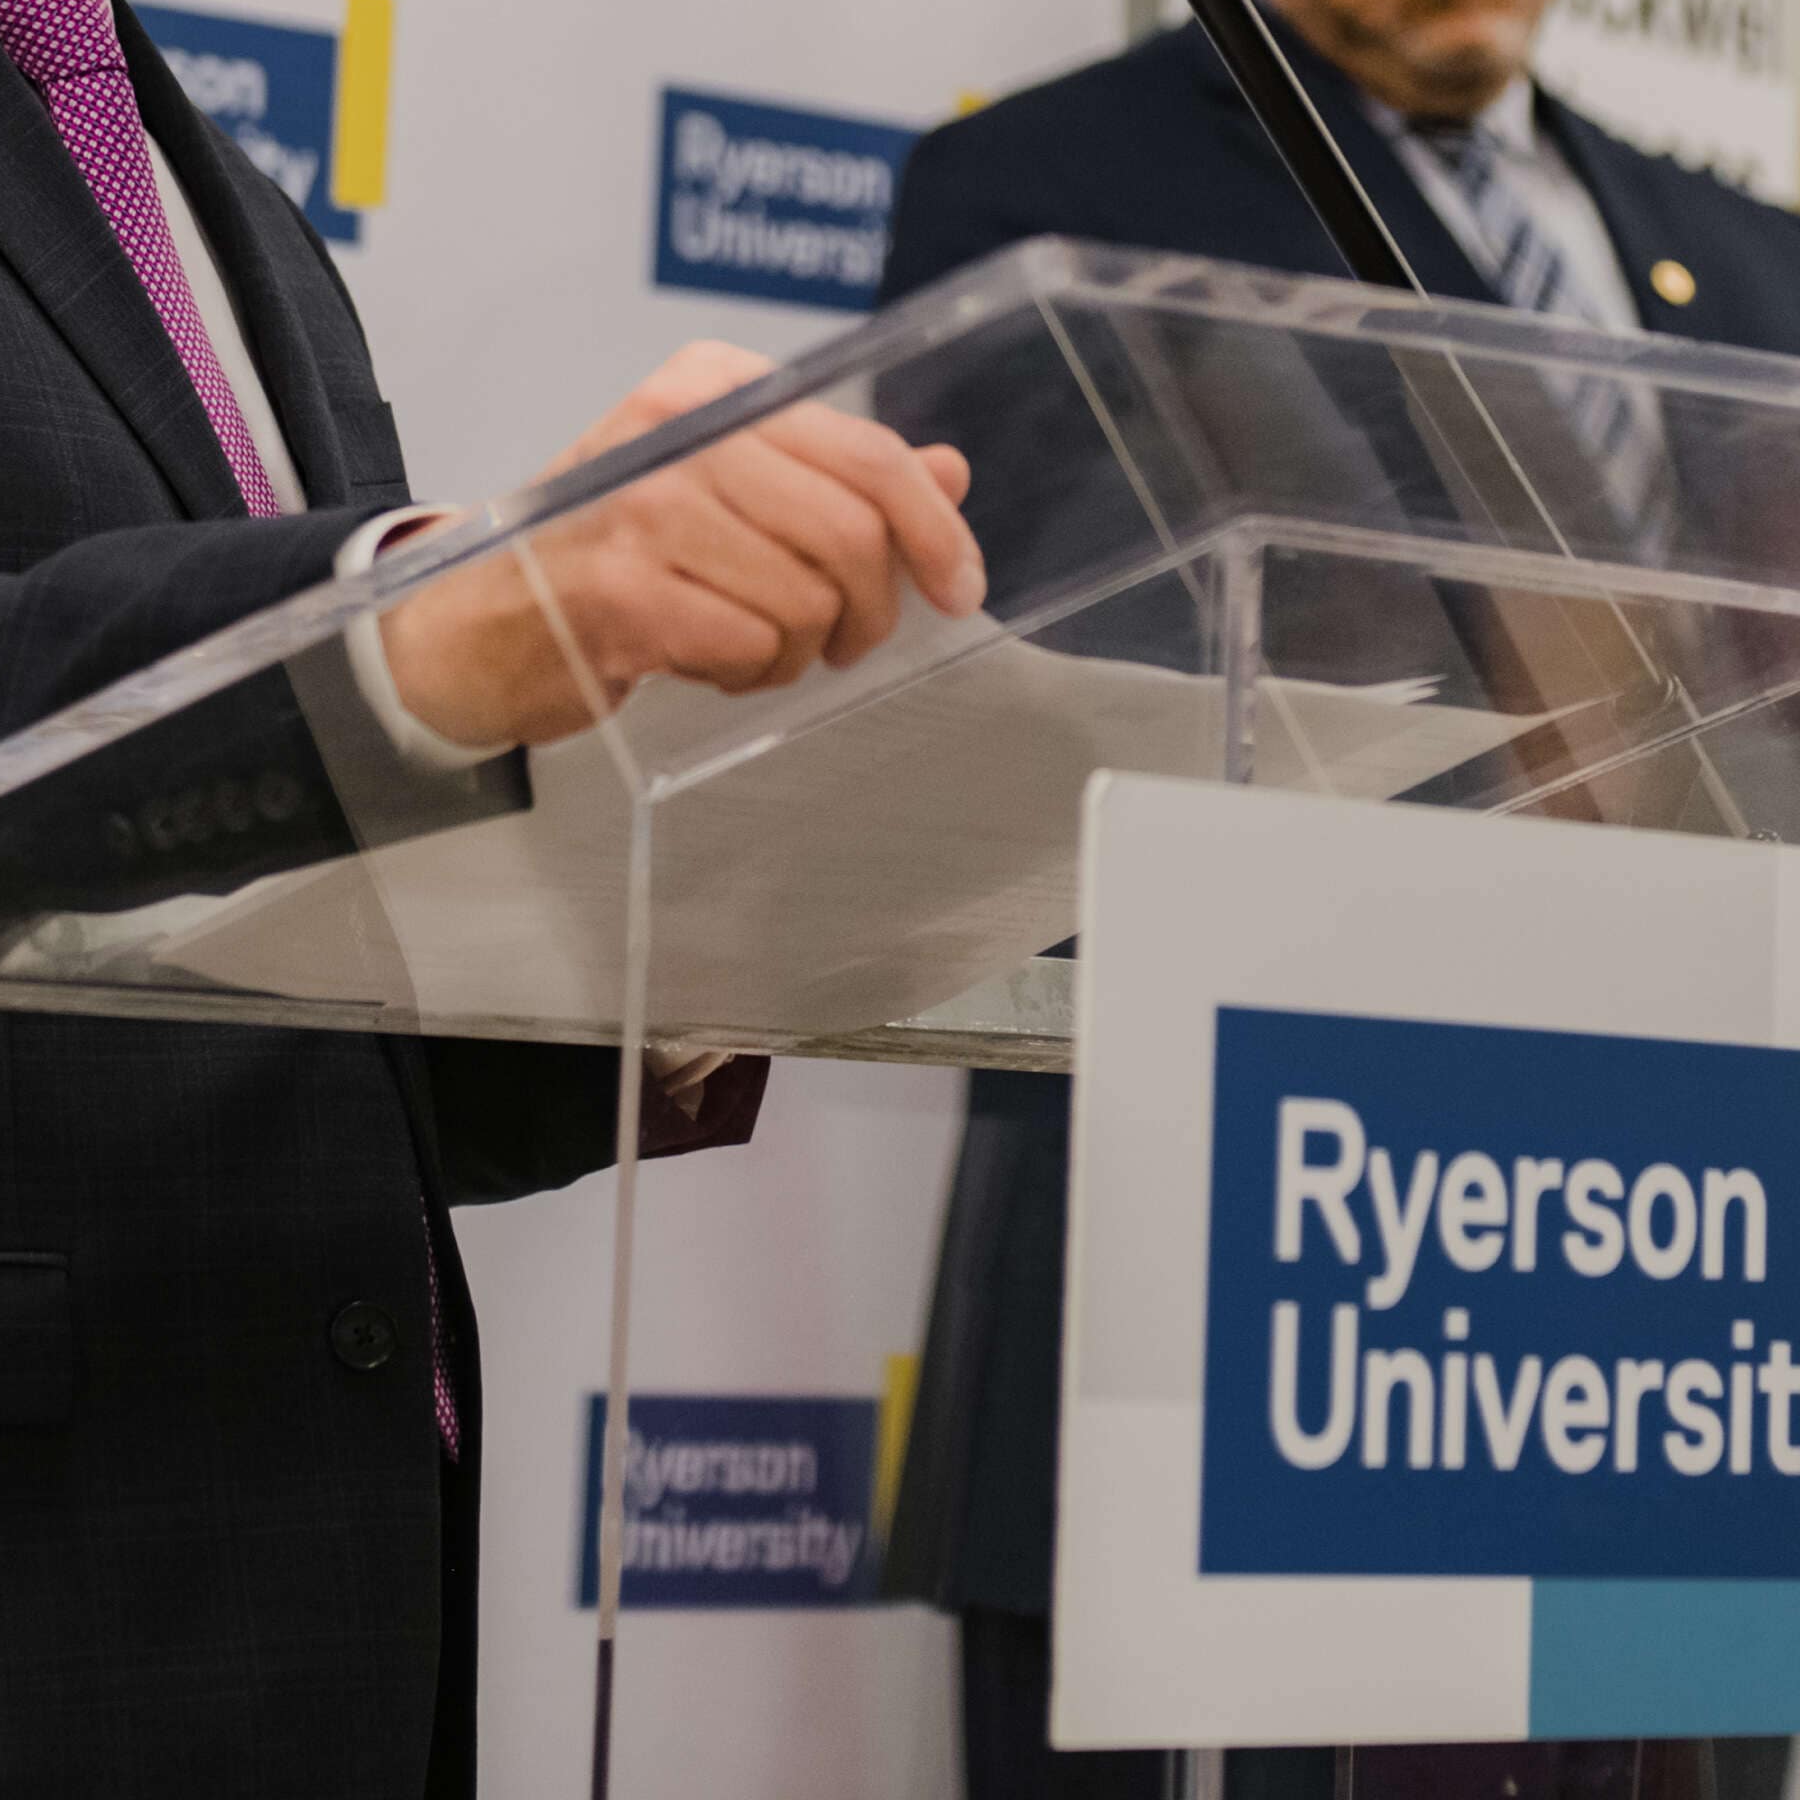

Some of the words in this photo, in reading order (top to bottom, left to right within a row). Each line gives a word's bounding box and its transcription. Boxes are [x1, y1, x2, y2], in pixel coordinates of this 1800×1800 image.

[673, 108, 893, 213] Ryerson
[670, 188, 894, 287] Universi
[1273, 1095, 1768, 1311] Ryerson
